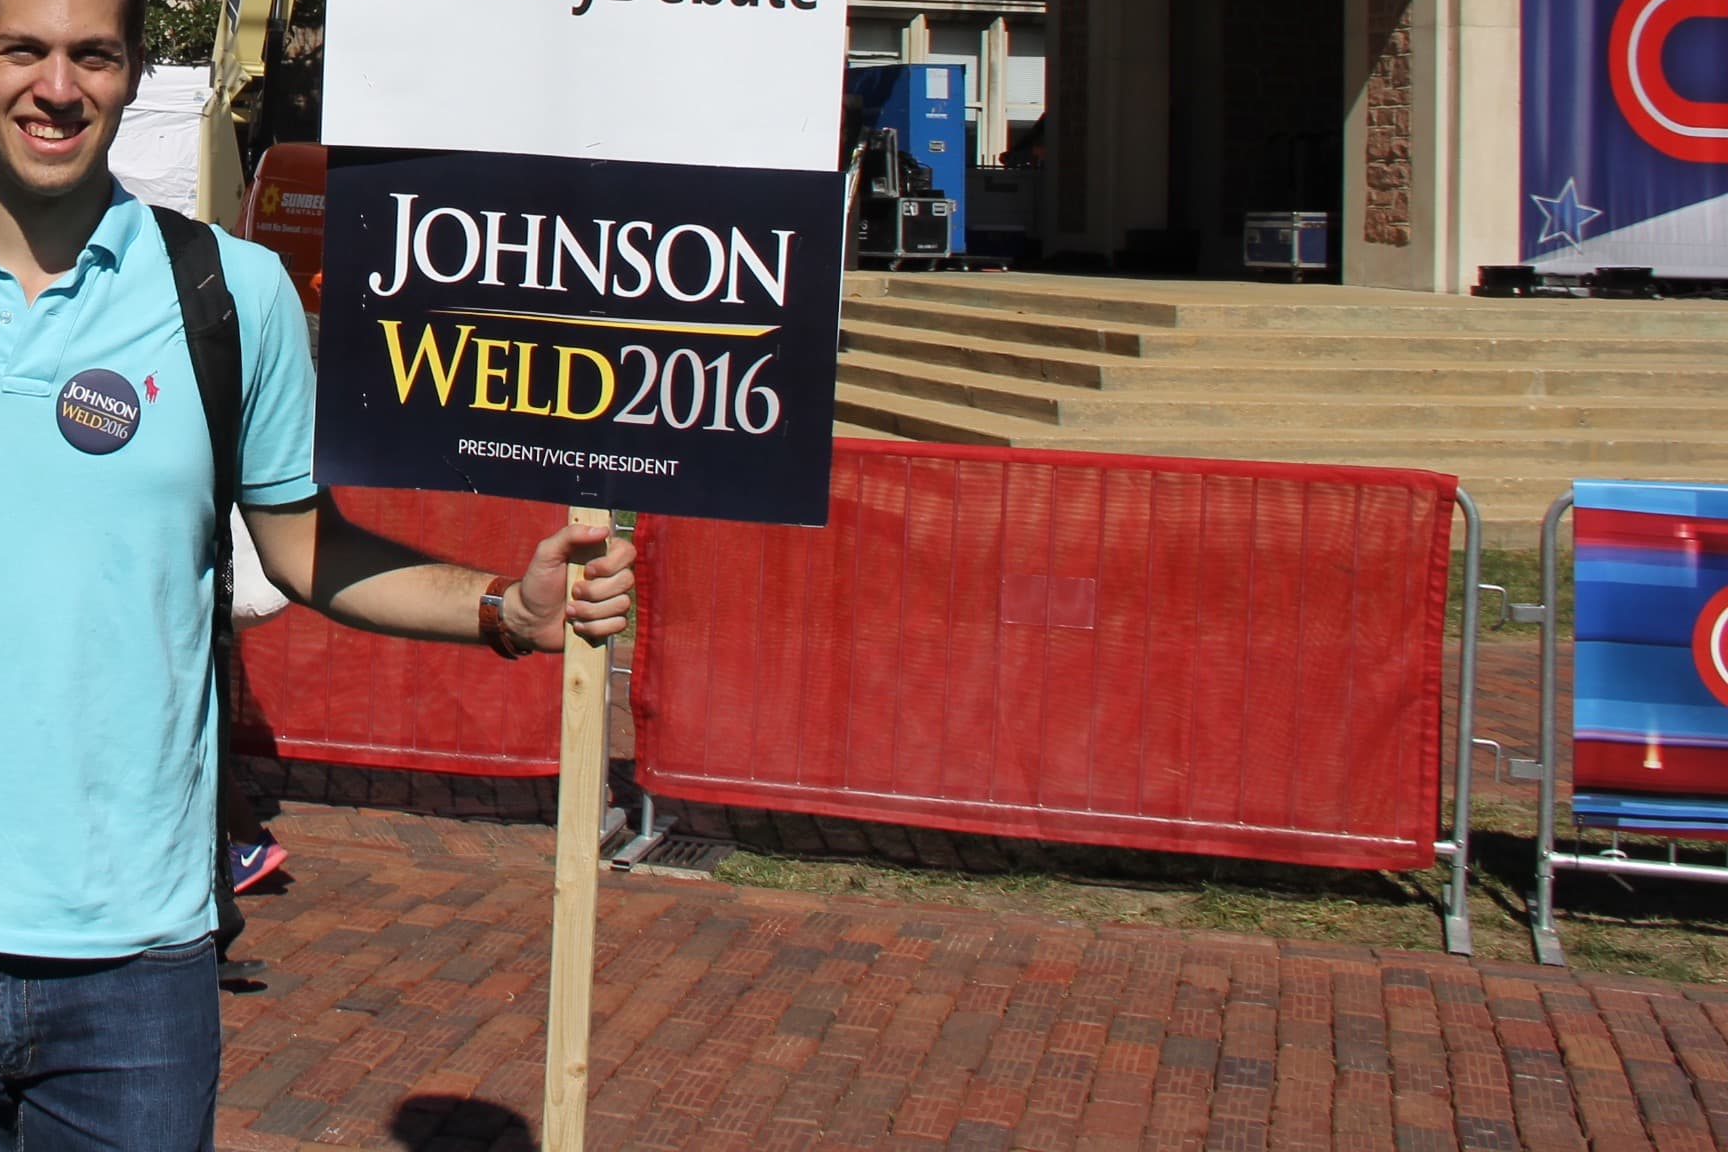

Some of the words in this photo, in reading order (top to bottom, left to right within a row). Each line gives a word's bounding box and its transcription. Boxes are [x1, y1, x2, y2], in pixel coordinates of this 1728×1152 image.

[368, 193, 796, 309] JOHNSON
[63, 381, 138, 421] JOHNSON
[458, 438, 584, 469] PRESIDENT/VICE
[588, 452, 679, 476] PRESIDENT
